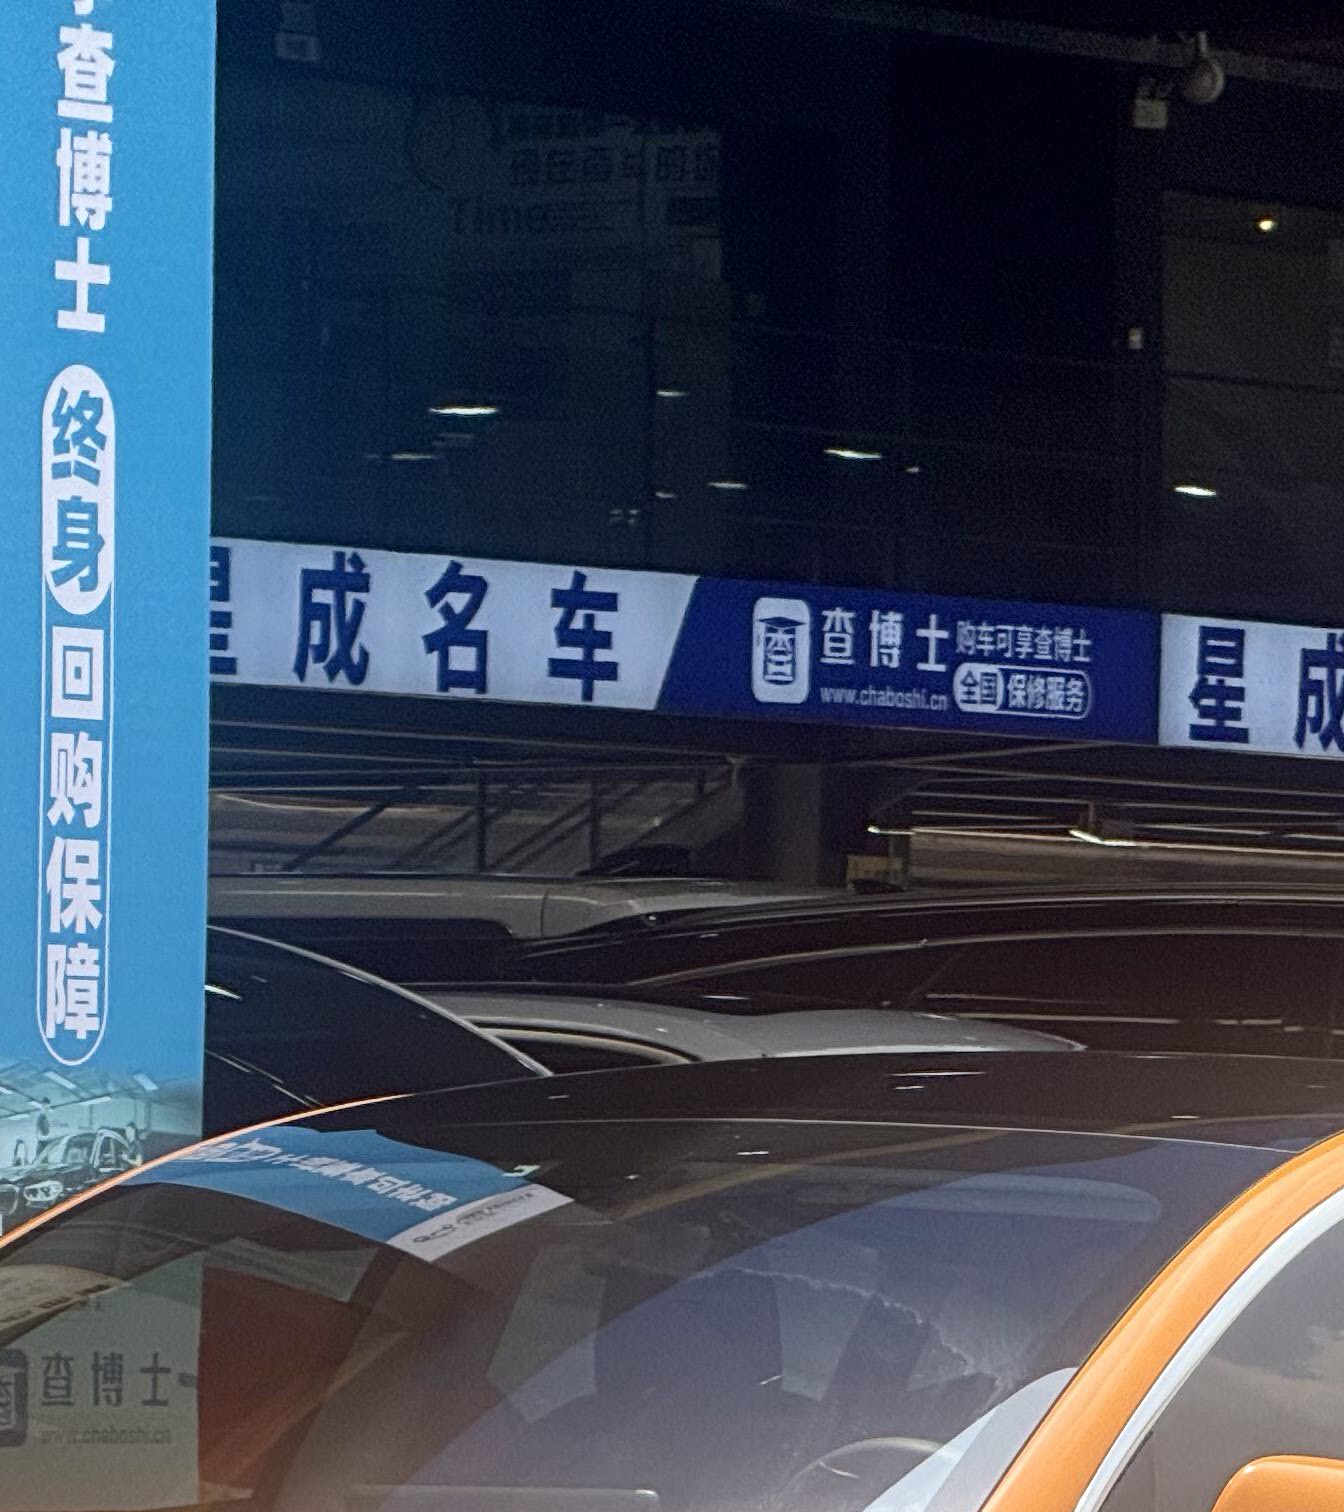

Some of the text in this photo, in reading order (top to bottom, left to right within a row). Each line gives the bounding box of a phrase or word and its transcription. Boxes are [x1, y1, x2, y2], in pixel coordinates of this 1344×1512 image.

[55, 0, 115, 333] 查博士
[820, 607, 949, 672] 查博士
[956, 621, 1092, 663] 购车可享查博士
[820, 685, 949, 712] www.chaboshi.cn
[40, 1351, 172, 1407] 查博士
